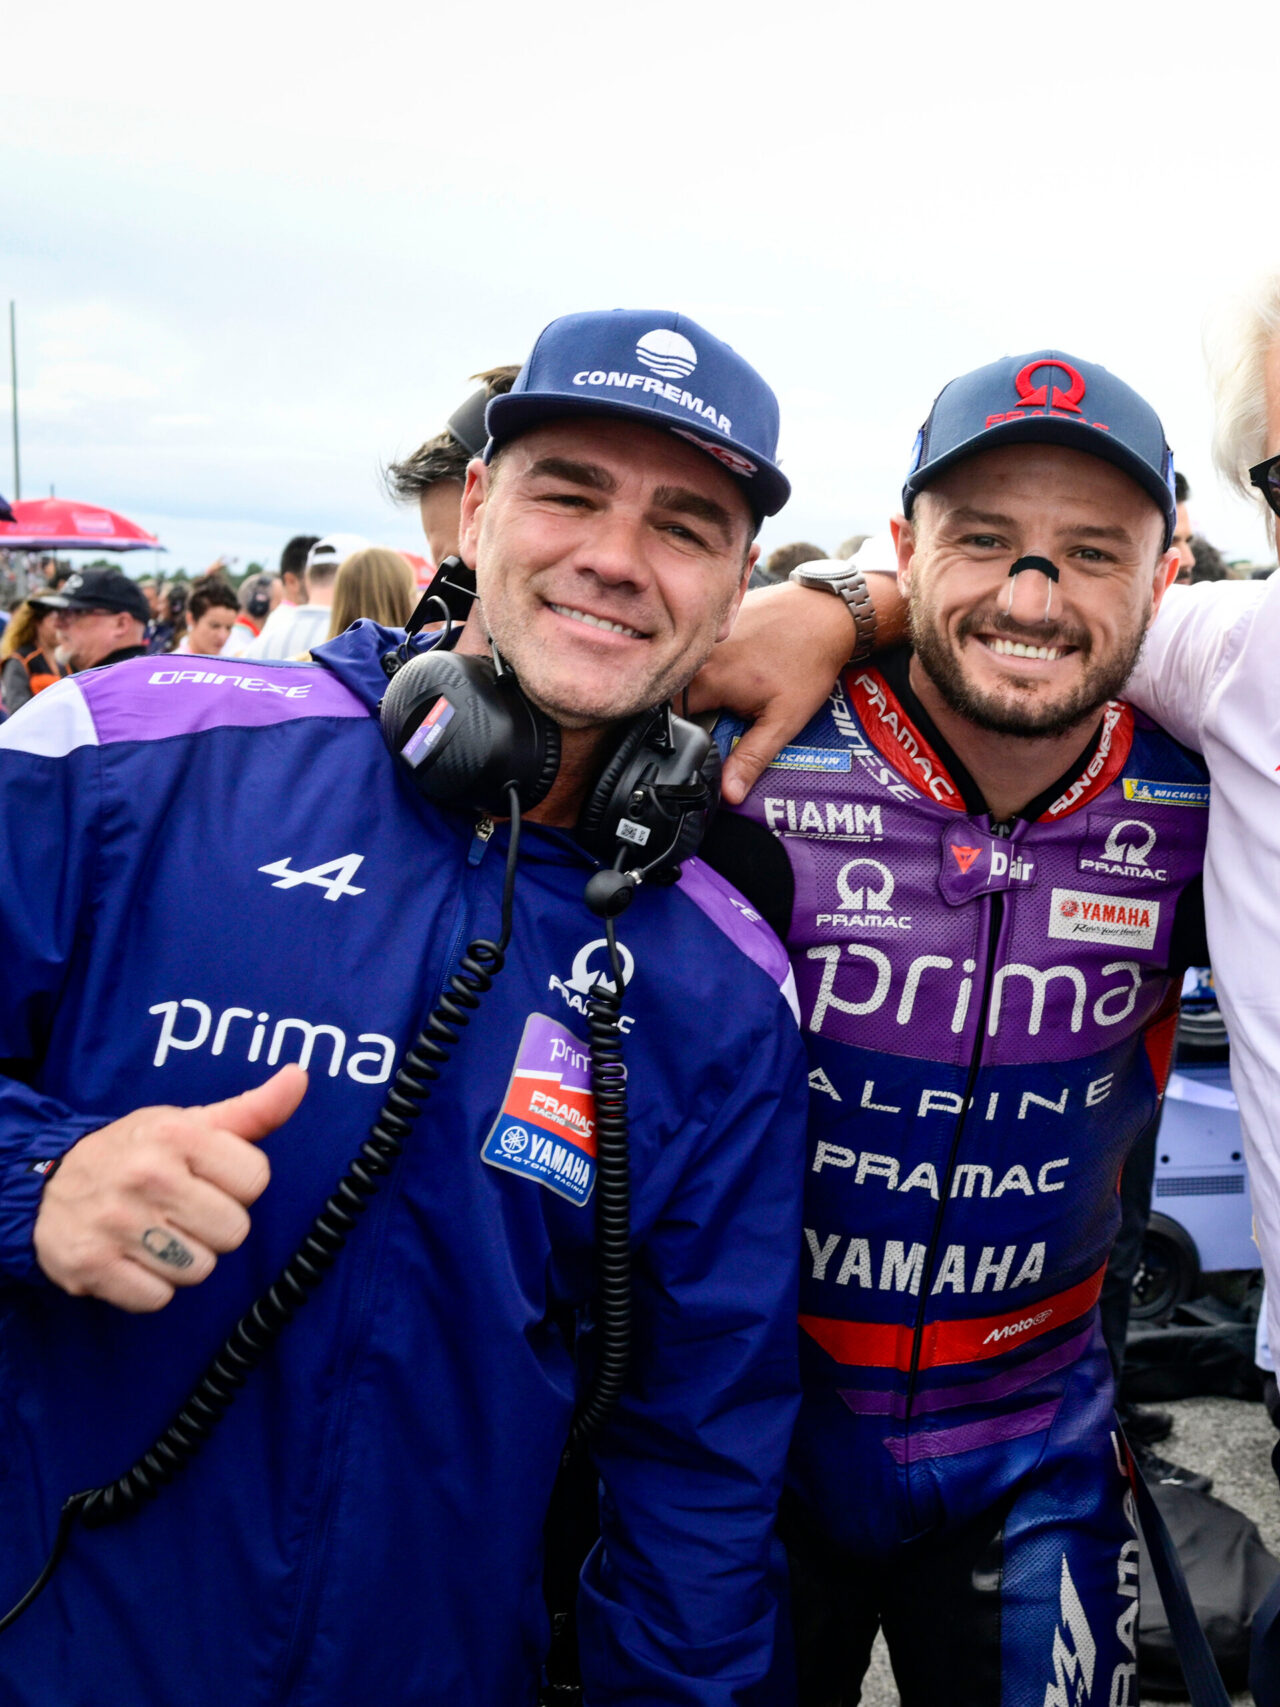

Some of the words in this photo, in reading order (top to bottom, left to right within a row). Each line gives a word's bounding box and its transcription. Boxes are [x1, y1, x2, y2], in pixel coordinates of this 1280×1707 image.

[573, 371, 732, 437] CONFREMAR
[854, 673, 954, 801] PRAMAC
[764, 798, 883, 834] FIAMM
[1048, 774, 1092, 816] SUN
[1154, 790, 1209, 800] MICHELI
[1080, 858, 1167, 882] PRAMAC
[816, 914, 912, 929] PRAMAC
[1081, 901, 1150, 927] YAMAHA
[548, 974, 636, 1034] PRAC
[806, 943, 1143, 1037] prima
[149, 998, 396, 1084] prima
[530, 1089, 595, 1134] PRAMAC
[807, 1066, 1115, 1121] ALPINE
[494, 1149, 553, 1175] FACTORY
[553, 1174, 585, 1195] RACING
[528, 1133, 590, 1189] YAMAHA
[811, 1139, 1070, 1201] PRAMAC
[803, 1227, 1047, 1297] YAMAHA
